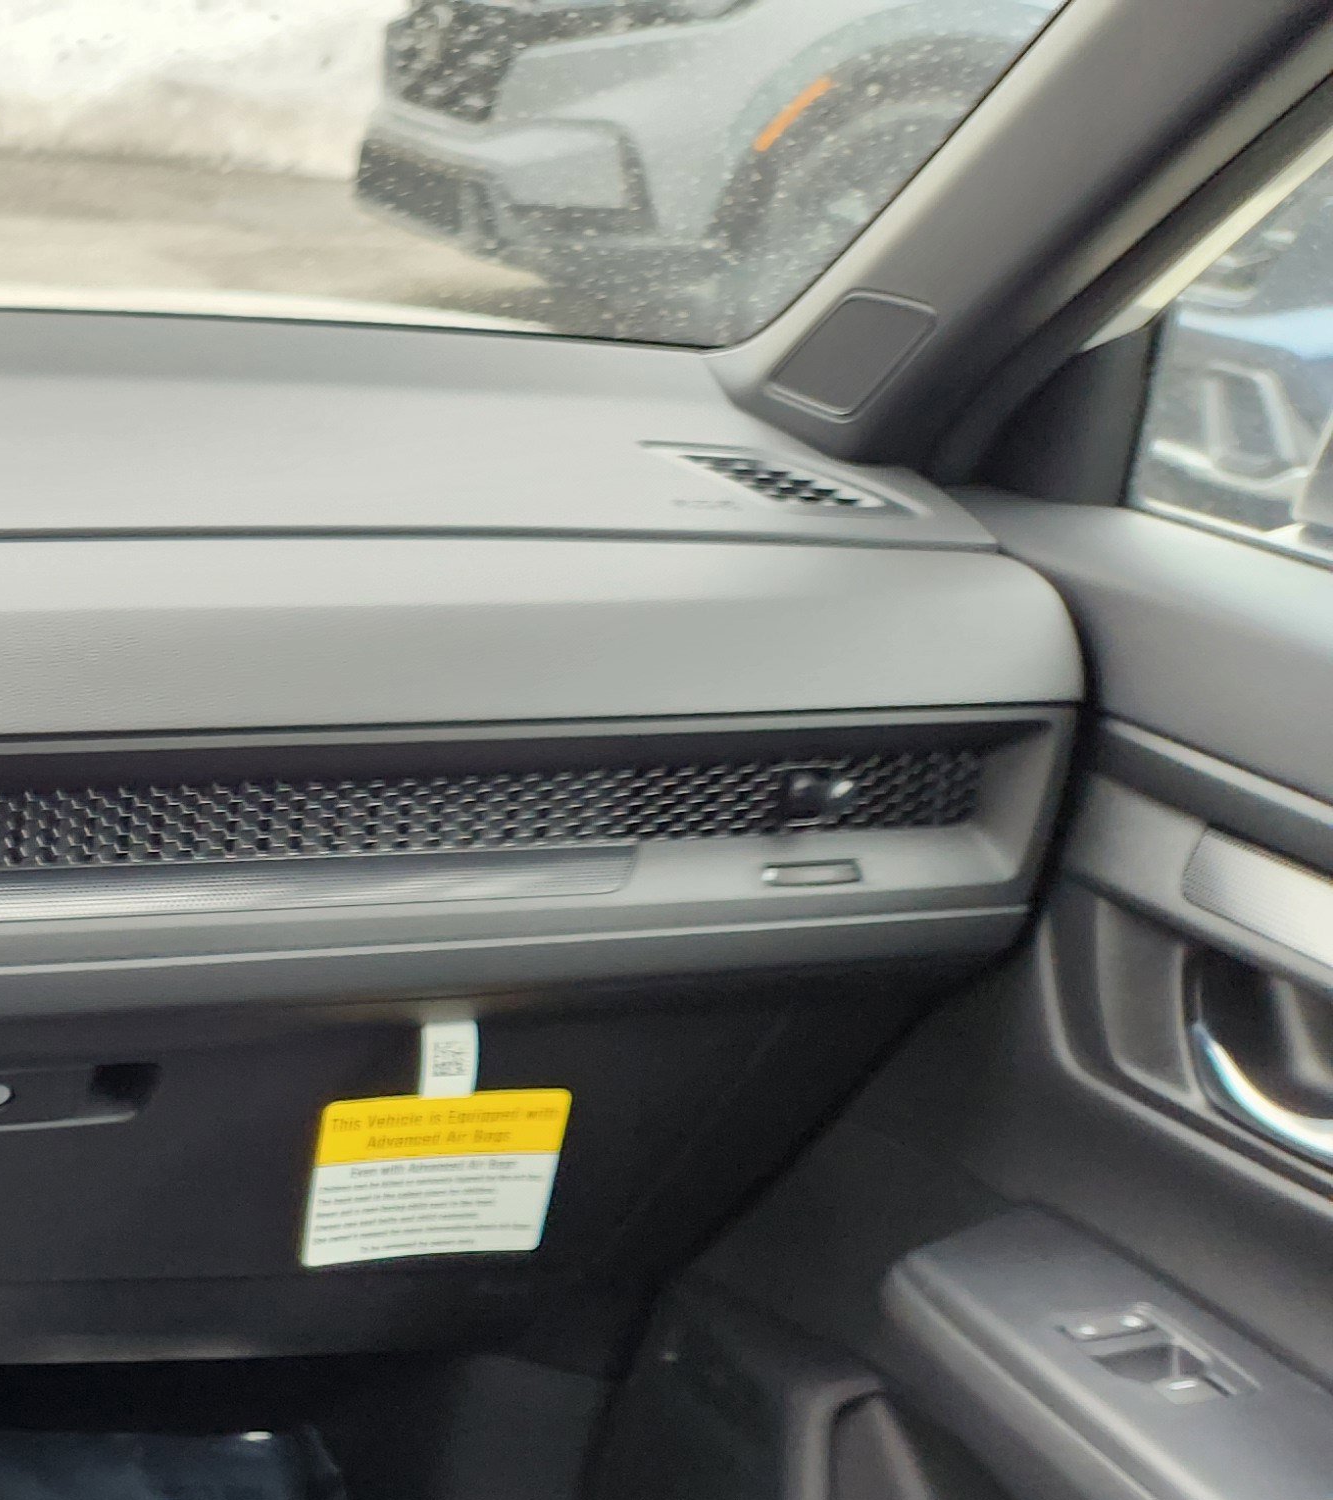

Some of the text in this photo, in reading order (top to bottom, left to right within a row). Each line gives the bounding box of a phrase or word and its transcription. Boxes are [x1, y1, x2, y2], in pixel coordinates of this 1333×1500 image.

[332, 1118, 361, 1132] This
[367, 1112, 423, 1128] Vehicle
[429, 1112, 441, 1125] is
[448, 1108, 520, 1125] Equipped
[367, 1133, 440, 1149] Advanced
[446, 1131, 467, 1144] Air
